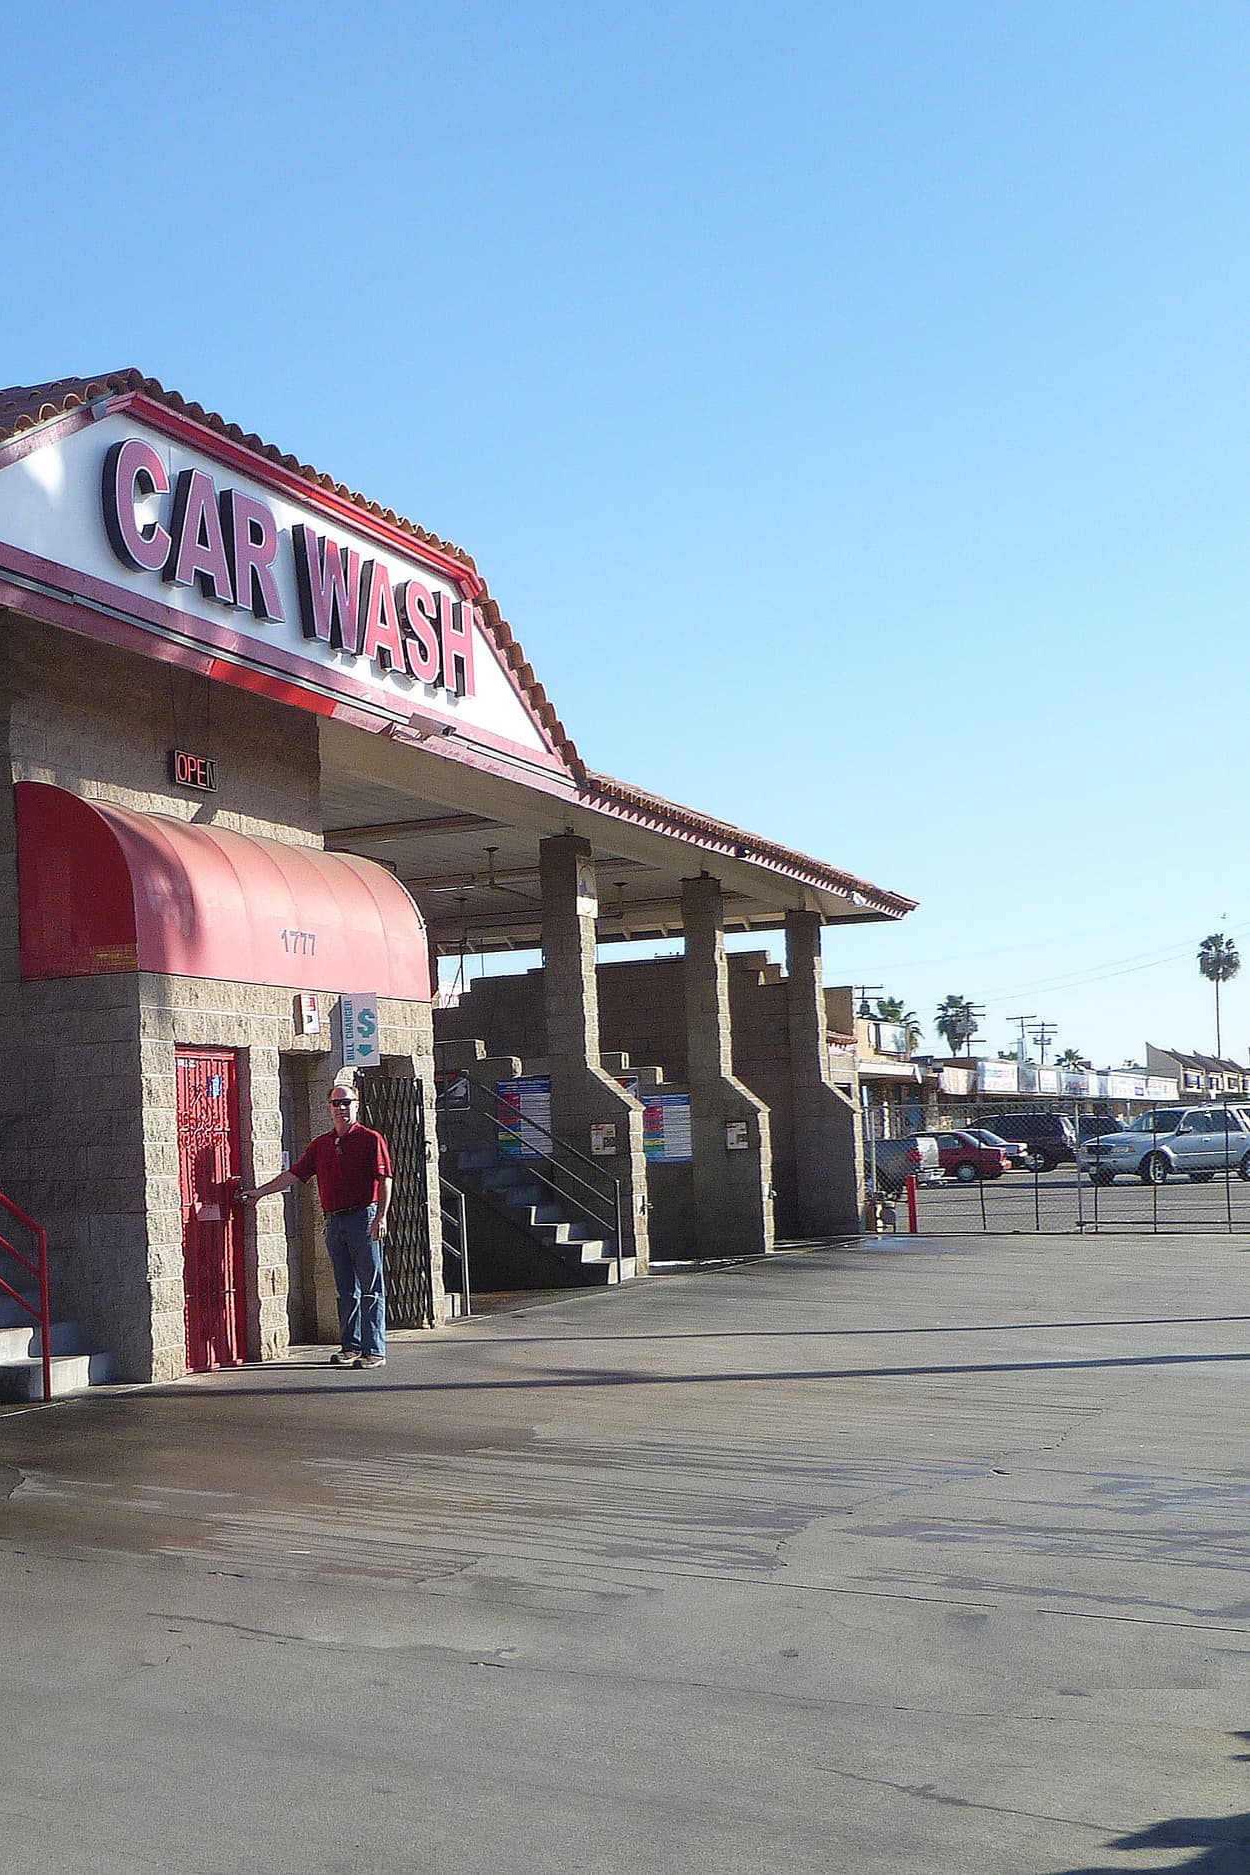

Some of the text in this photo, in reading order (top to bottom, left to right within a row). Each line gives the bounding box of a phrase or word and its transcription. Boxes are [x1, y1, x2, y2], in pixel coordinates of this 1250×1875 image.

[102, 438, 476, 699] CAR WASH
[177, 754, 216, 789] OPEN
[281, 929, 316, 956] 1777
[344, 1000, 355, 1060] BILL CHANGER
